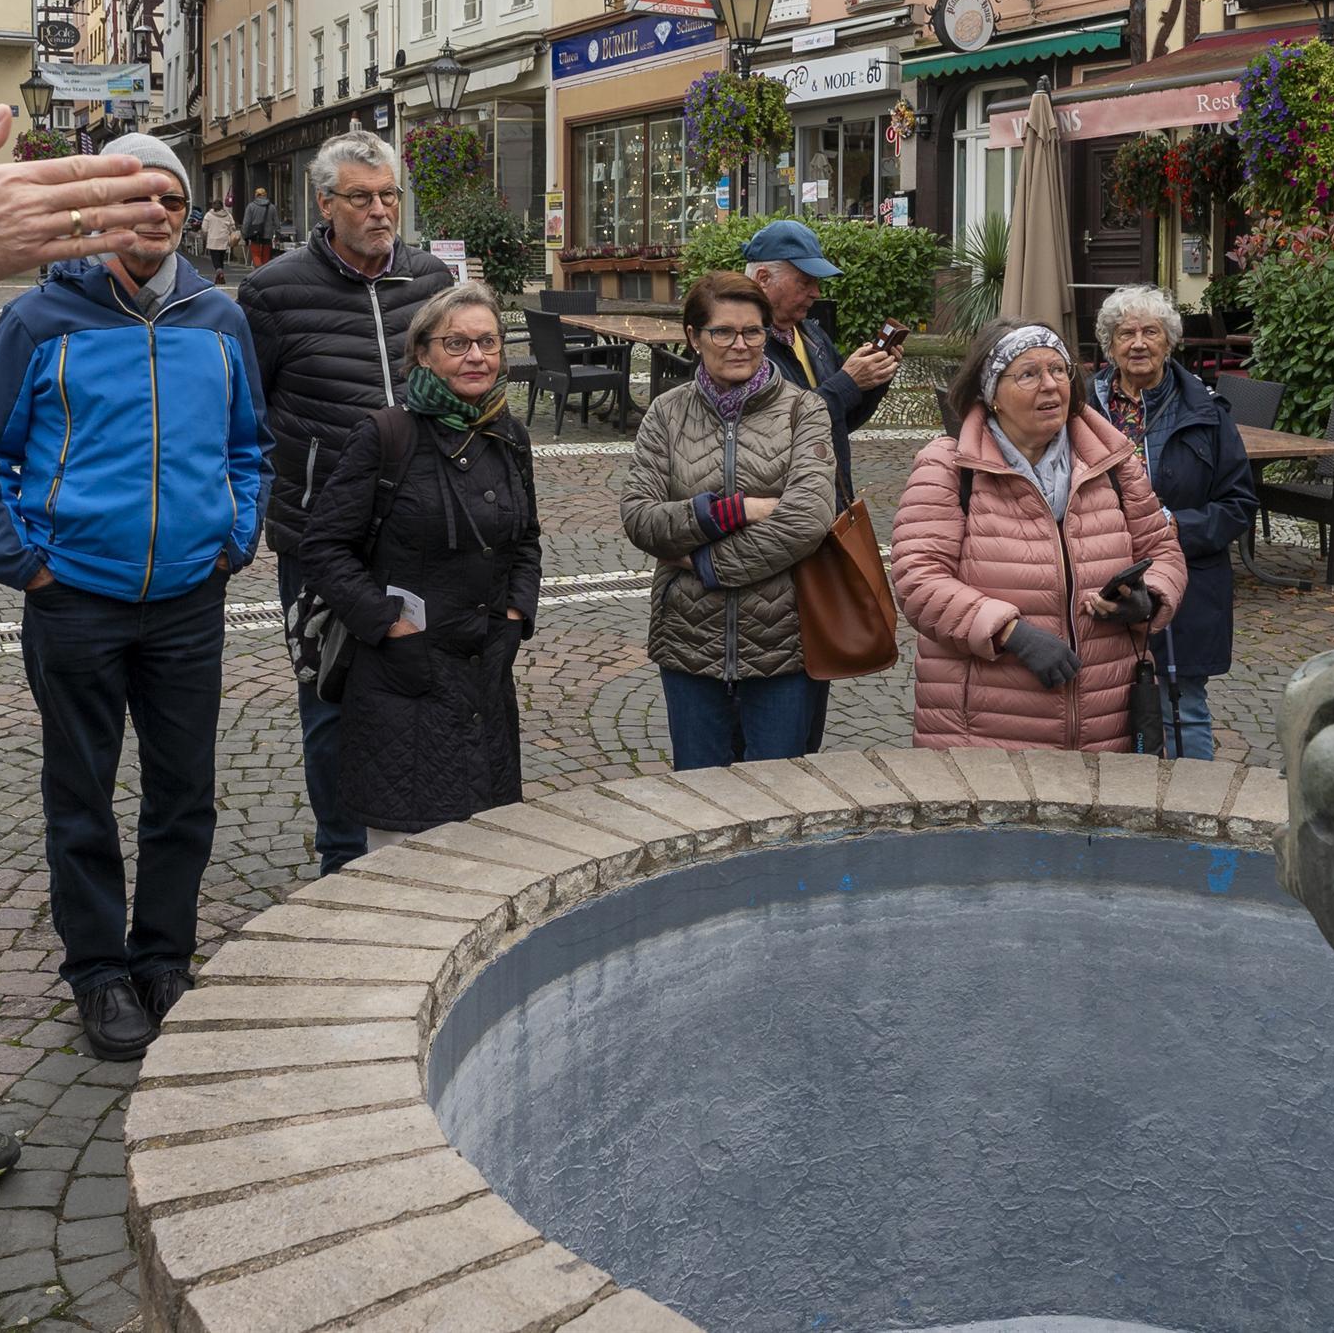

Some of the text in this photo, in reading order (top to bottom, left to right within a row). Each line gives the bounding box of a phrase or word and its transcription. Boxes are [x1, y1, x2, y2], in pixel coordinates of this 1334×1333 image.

[651, 4, 700, 16] DUGENA
[602, 29, 638, 60] BÜRKLE
[824, 71, 855, 91] MODE
[867, 67, 882, 84] 60
[1197, 92, 1237, 112] Rest
